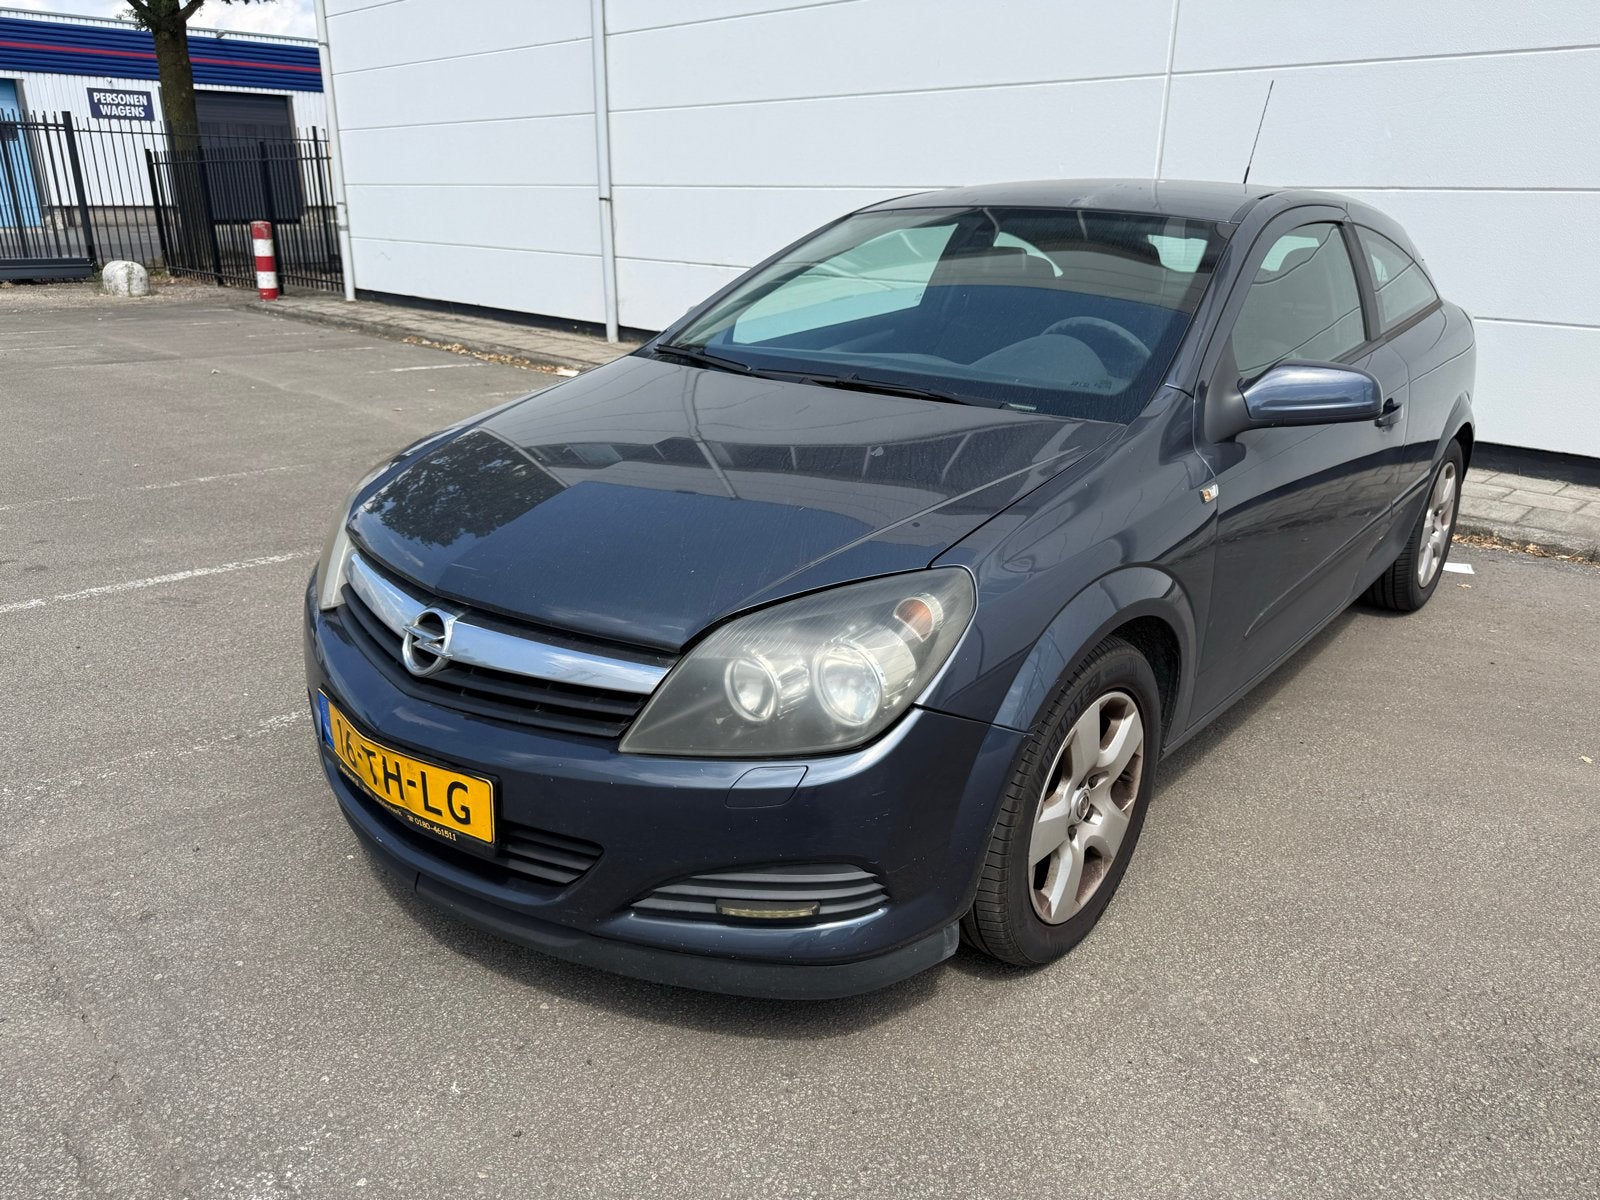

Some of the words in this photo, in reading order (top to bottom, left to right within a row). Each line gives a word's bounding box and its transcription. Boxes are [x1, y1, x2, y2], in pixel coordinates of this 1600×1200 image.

[93, 92, 147, 105] PERSONEN
[99, 104, 145, 117] WAGENS
[337, 719, 471, 825] 16-TH-LG
